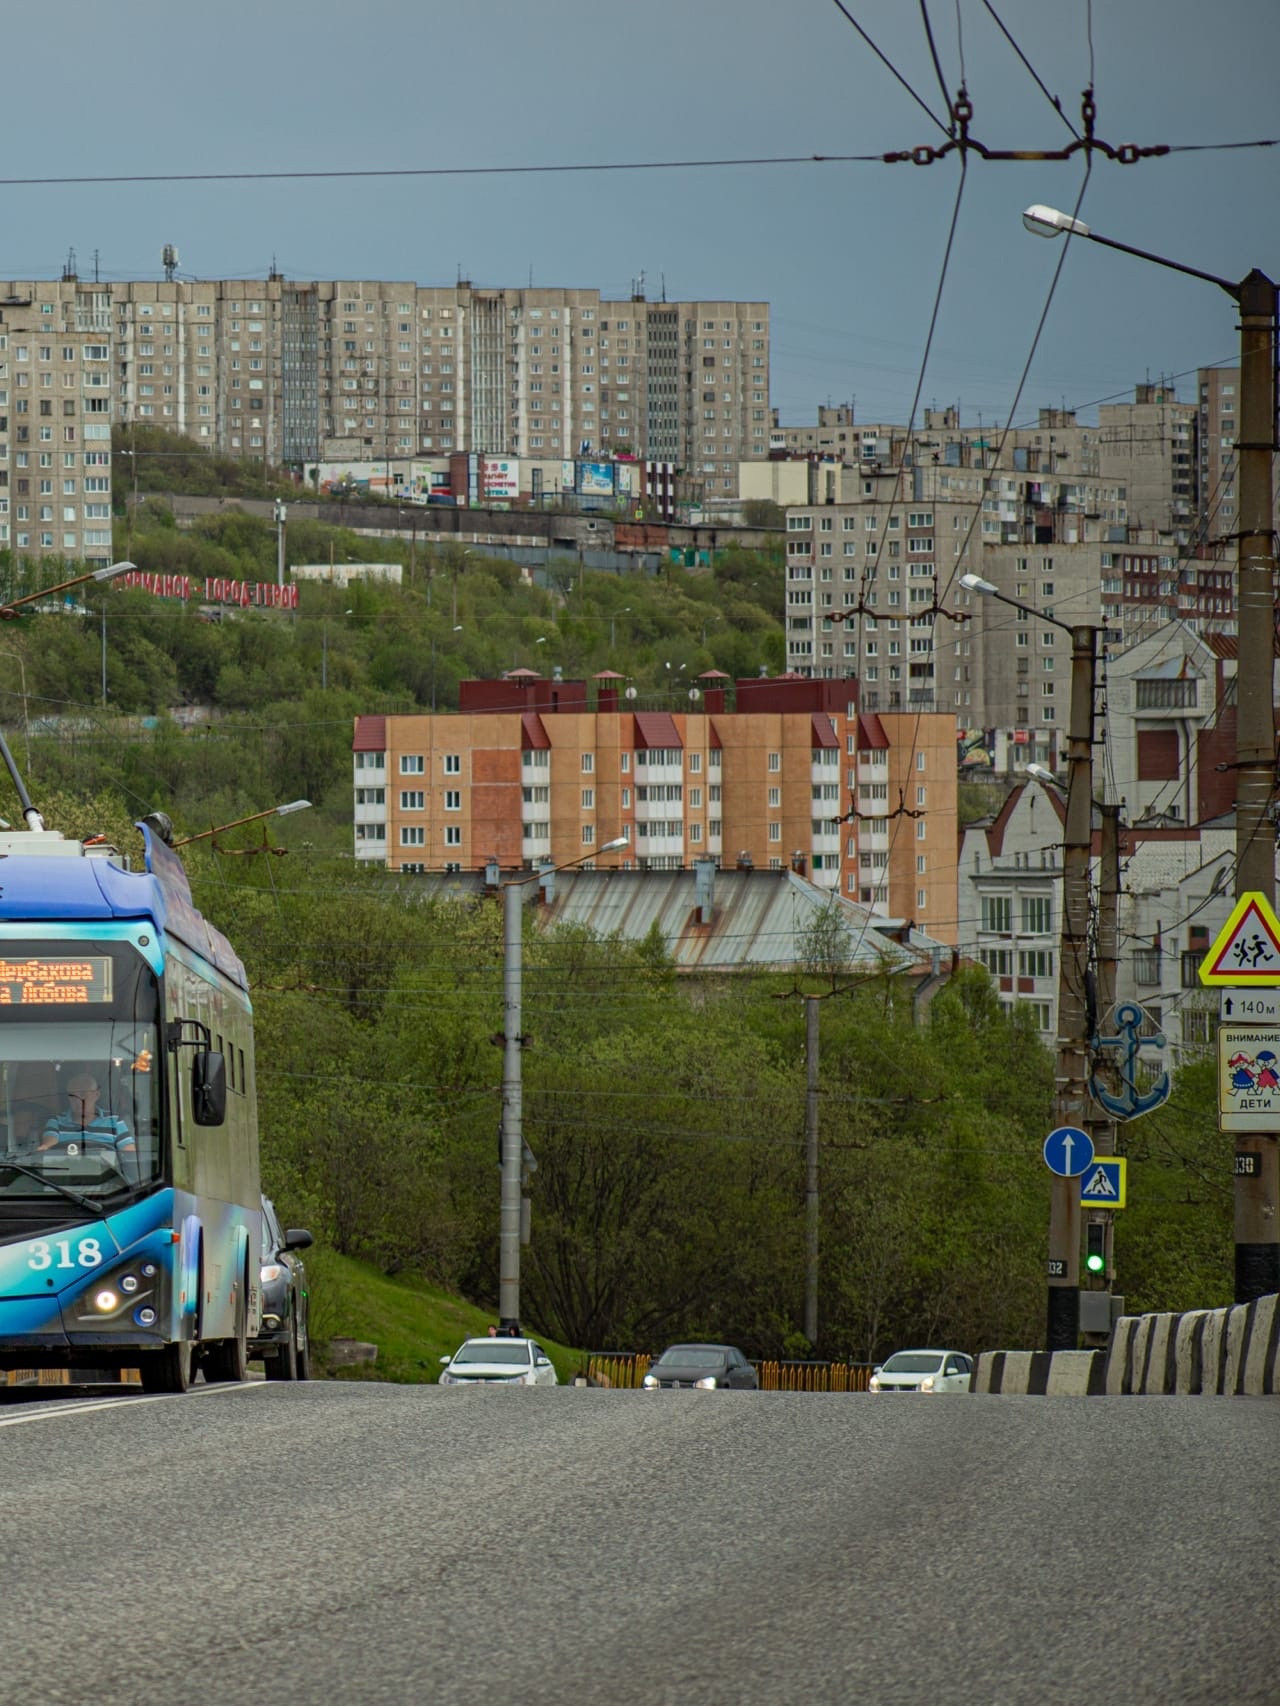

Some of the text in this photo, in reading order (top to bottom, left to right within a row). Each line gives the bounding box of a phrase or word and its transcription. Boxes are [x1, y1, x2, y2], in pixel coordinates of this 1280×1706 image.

[20, 981, 89, 1004] Лобова
[1239, 1099, 1271, 1109] ДЕТИ
[28, 1238, 102, 1270] 318
